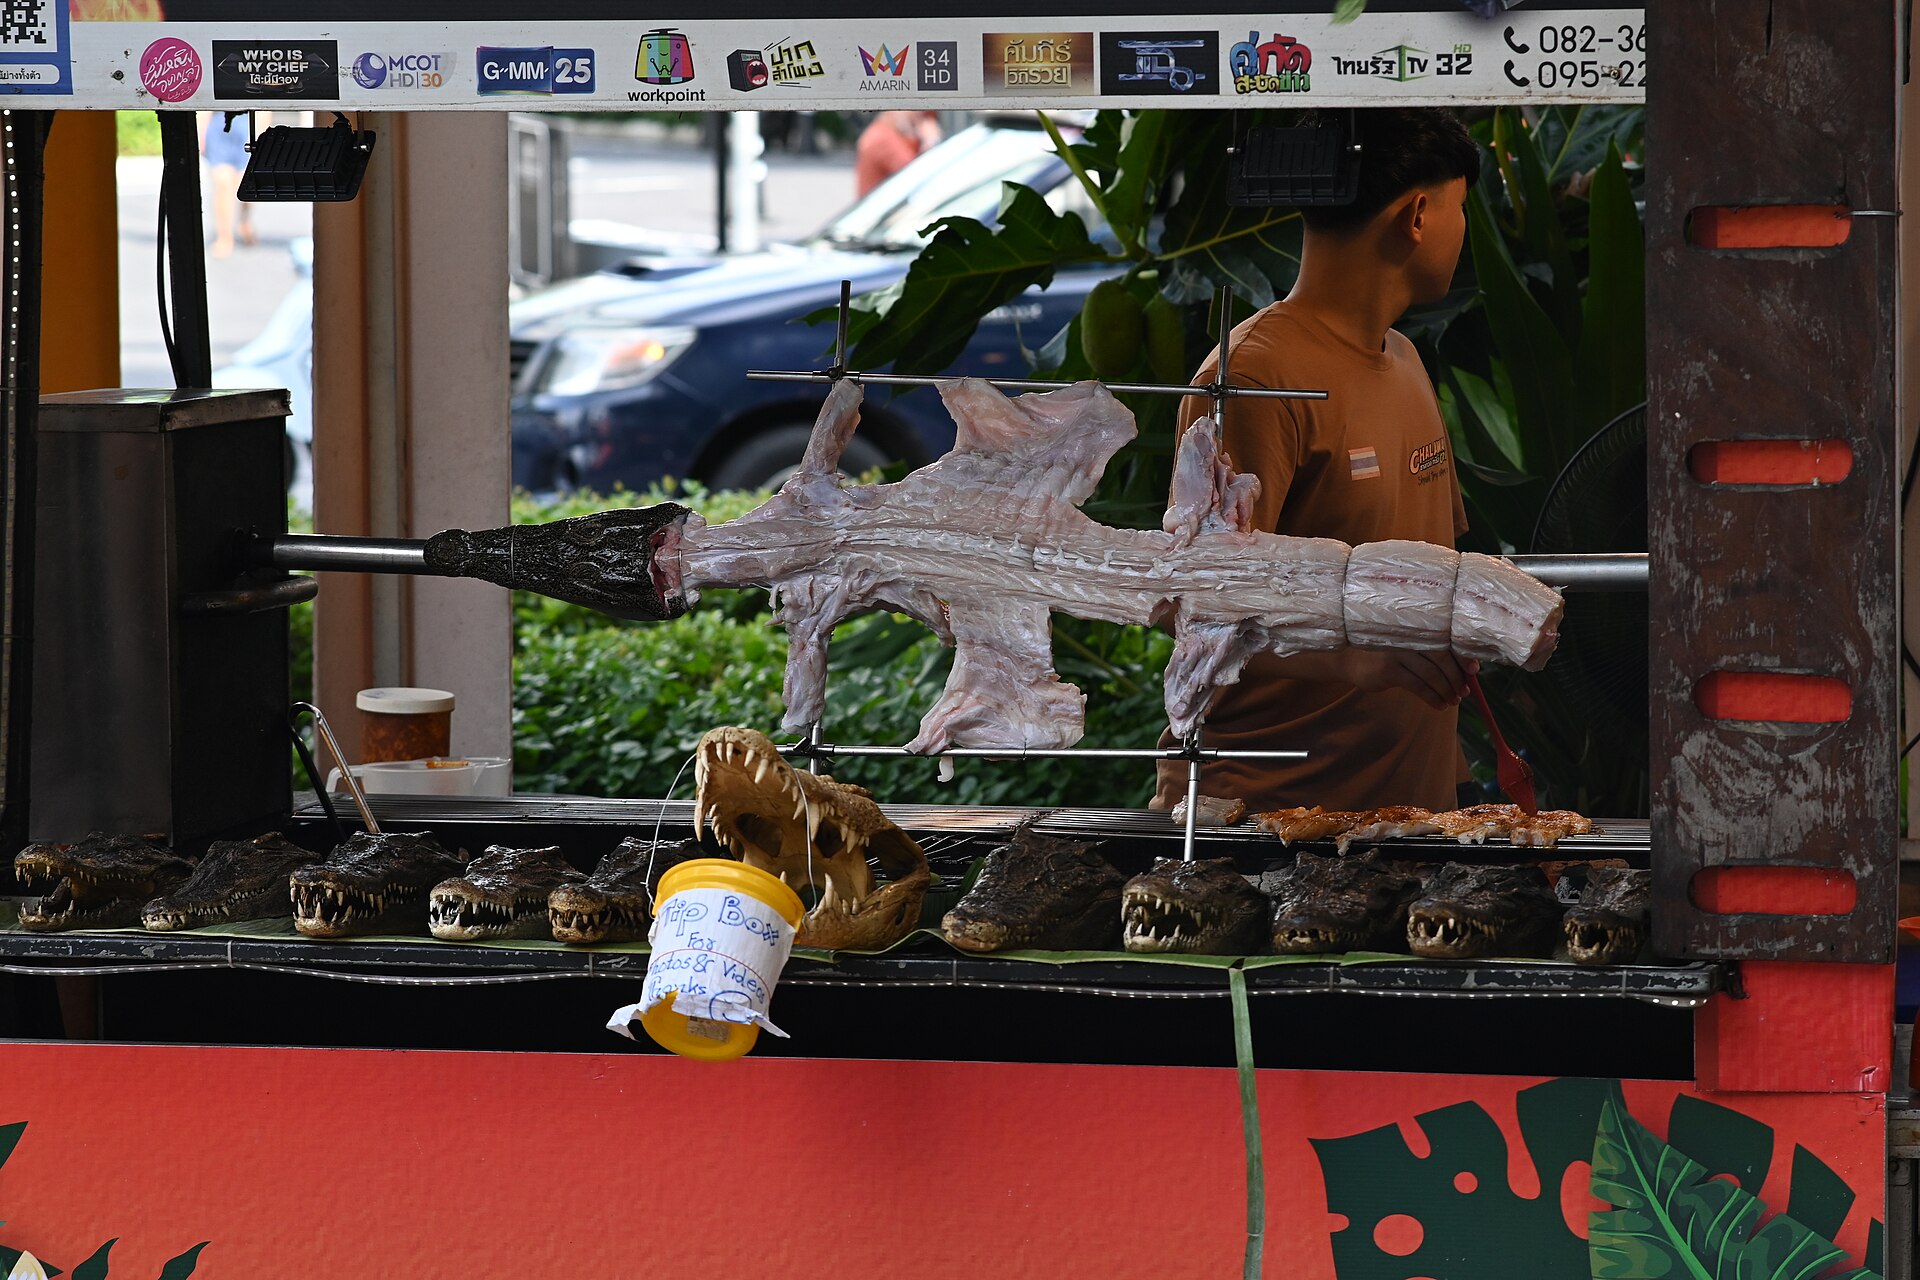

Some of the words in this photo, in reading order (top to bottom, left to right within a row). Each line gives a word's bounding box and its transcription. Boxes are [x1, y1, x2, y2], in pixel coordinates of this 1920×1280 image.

[243, 49, 284, 61] WHO
[287, 49, 303, 60] IS
[1453, 44, 1472, 53] HD
[388, 54, 441, 71] MCOT
[924, 49, 950, 66] 34
[1407, 56, 1428, 74] TV
[1436, 53, 1472, 75] 32
[238, 61, 263, 73] MY
[266, 61, 309, 73] CHEF
[555, 57, 591, 84] 25
[389, 73, 414, 88] HD
[421, 73, 443, 88] 30
[924, 70, 951, 83] HD
[859, 80, 910, 91] AMARIN
[627, 88, 706, 104] workpoint
[662, 898, 709, 937] Tip
[718, 895, 780, 947] Box
[688, 931, 717, 951] For
[650, 951, 691, 976] hotos
